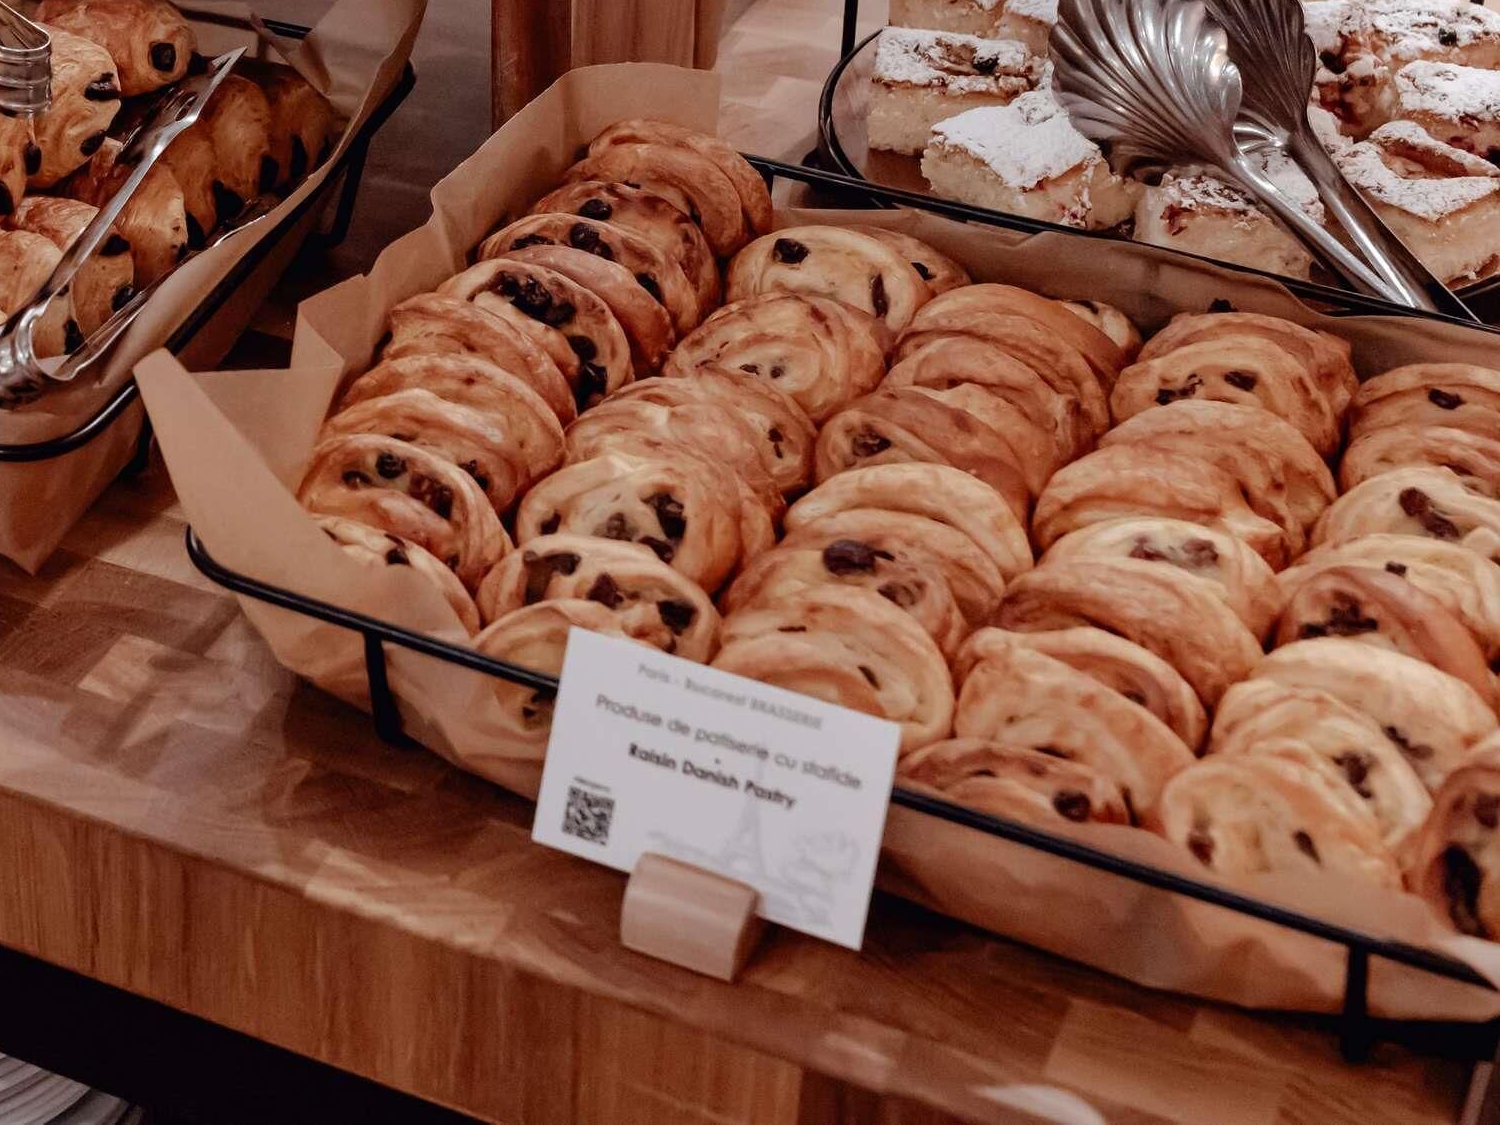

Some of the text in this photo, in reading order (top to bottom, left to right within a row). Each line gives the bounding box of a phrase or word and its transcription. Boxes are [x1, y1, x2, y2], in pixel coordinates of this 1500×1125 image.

[595, 693, 662, 726] Produse
[667, 719, 690, 736] de
[774, 753, 796, 769] cu
[628, 742, 796, 811] Raisin Danish Pastry
